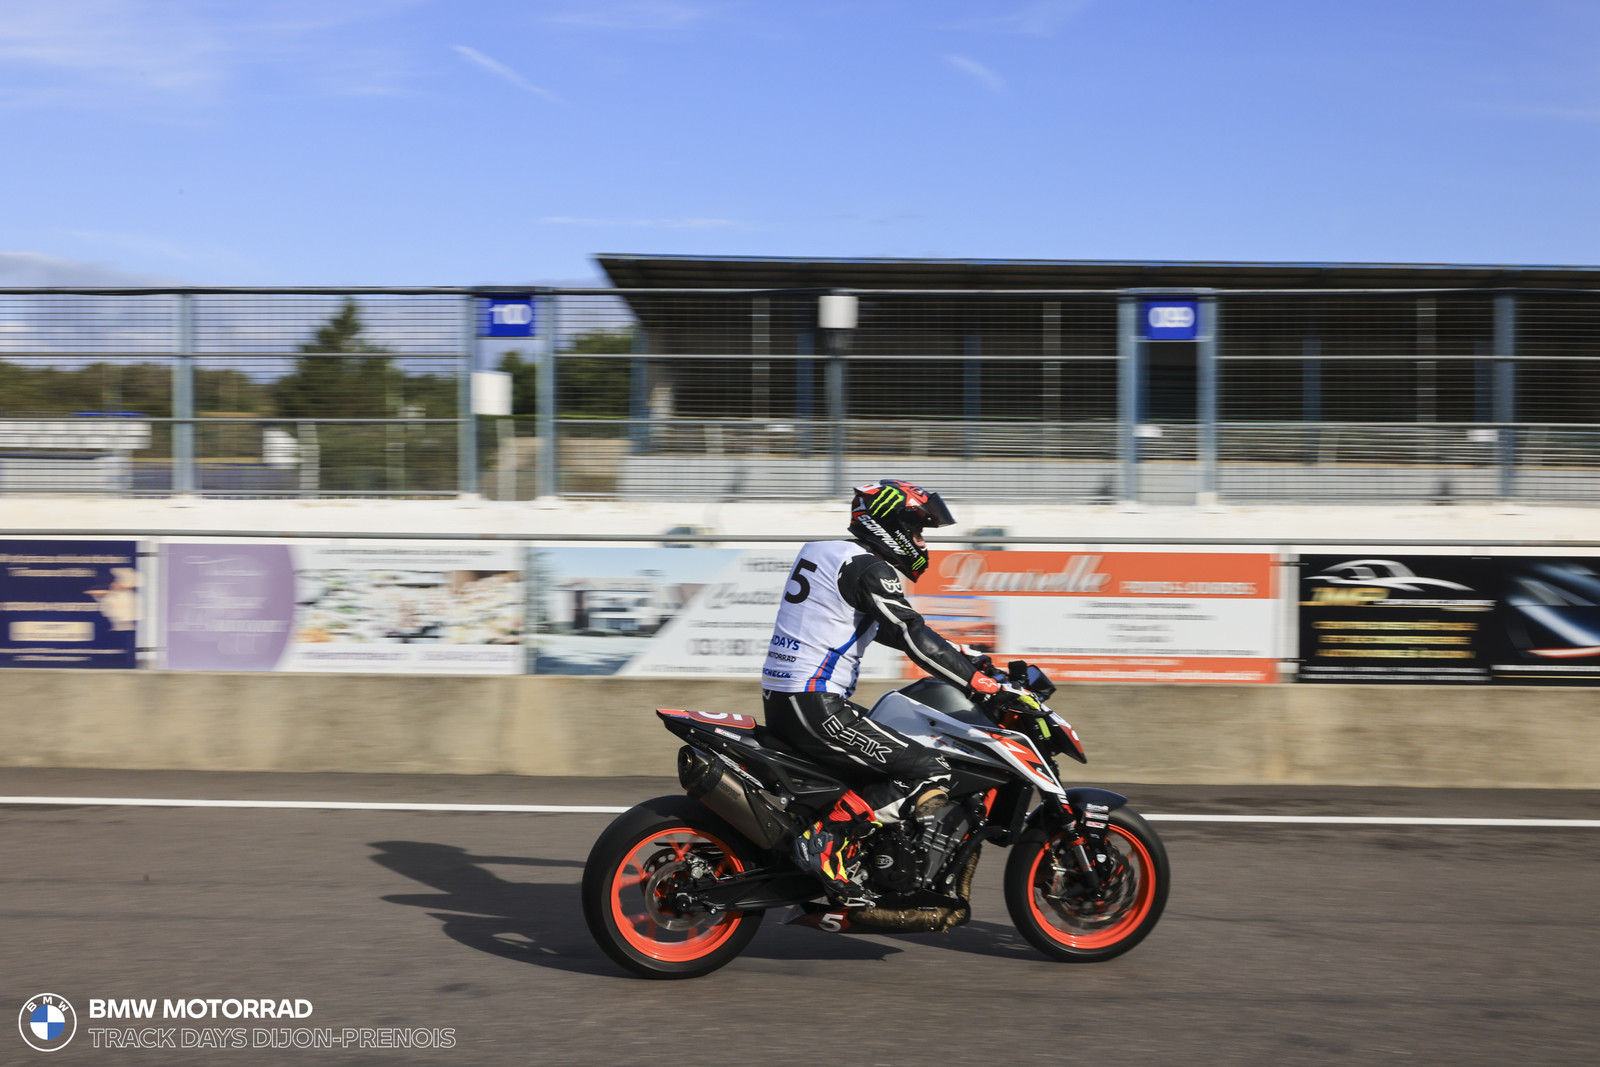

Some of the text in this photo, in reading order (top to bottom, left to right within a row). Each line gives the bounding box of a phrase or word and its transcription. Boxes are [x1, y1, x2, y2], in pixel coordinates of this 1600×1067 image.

[857, 514, 907, 556] SCORPION
[784, 558, 818, 604] 5
[768, 650, 797, 663] OTORRAD
[771, 635, 800, 651] DAYS
[822, 715, 893, 764] BERIK
[818, 913, 844, 933] 5
